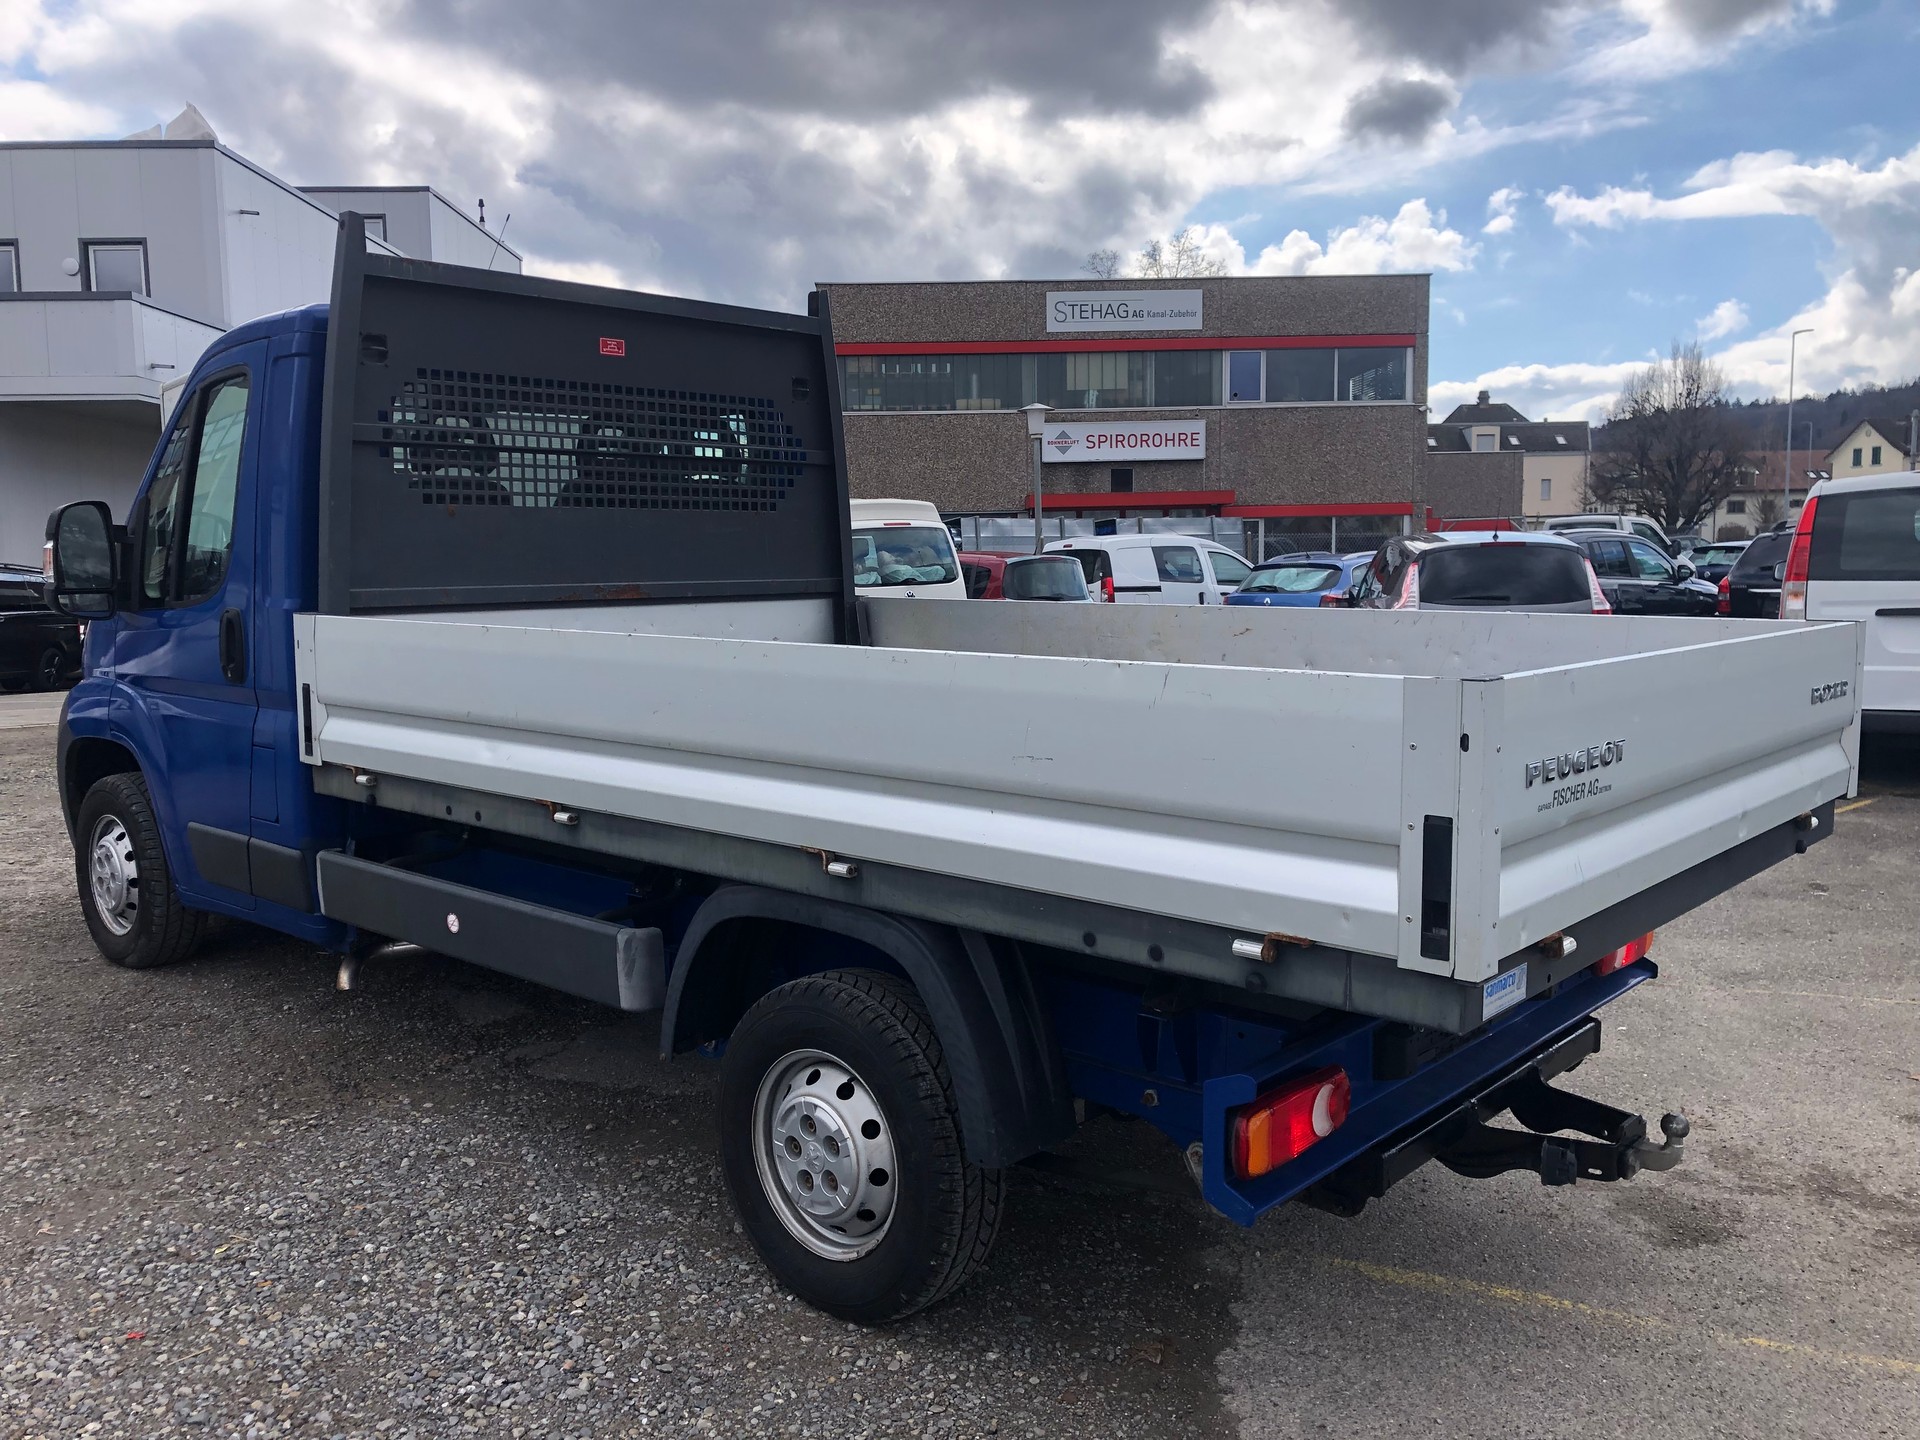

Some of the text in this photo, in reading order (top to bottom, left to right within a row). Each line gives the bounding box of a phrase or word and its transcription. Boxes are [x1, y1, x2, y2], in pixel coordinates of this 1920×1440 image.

[1054, 301, 1198, 323] STEHAG AG Kanal-Zubehör
[1085, 432, 1201, 449] SPIROROHRE
[1811, 680, 1849, 705] BOXER
[1525, 738, 1626, 789] PEUGEOT
[1552, 782, 1586, 809] FISCHER
[1586, 778, 1599, 798] AG
[1485, 972, 1516, 999] sanmarco
